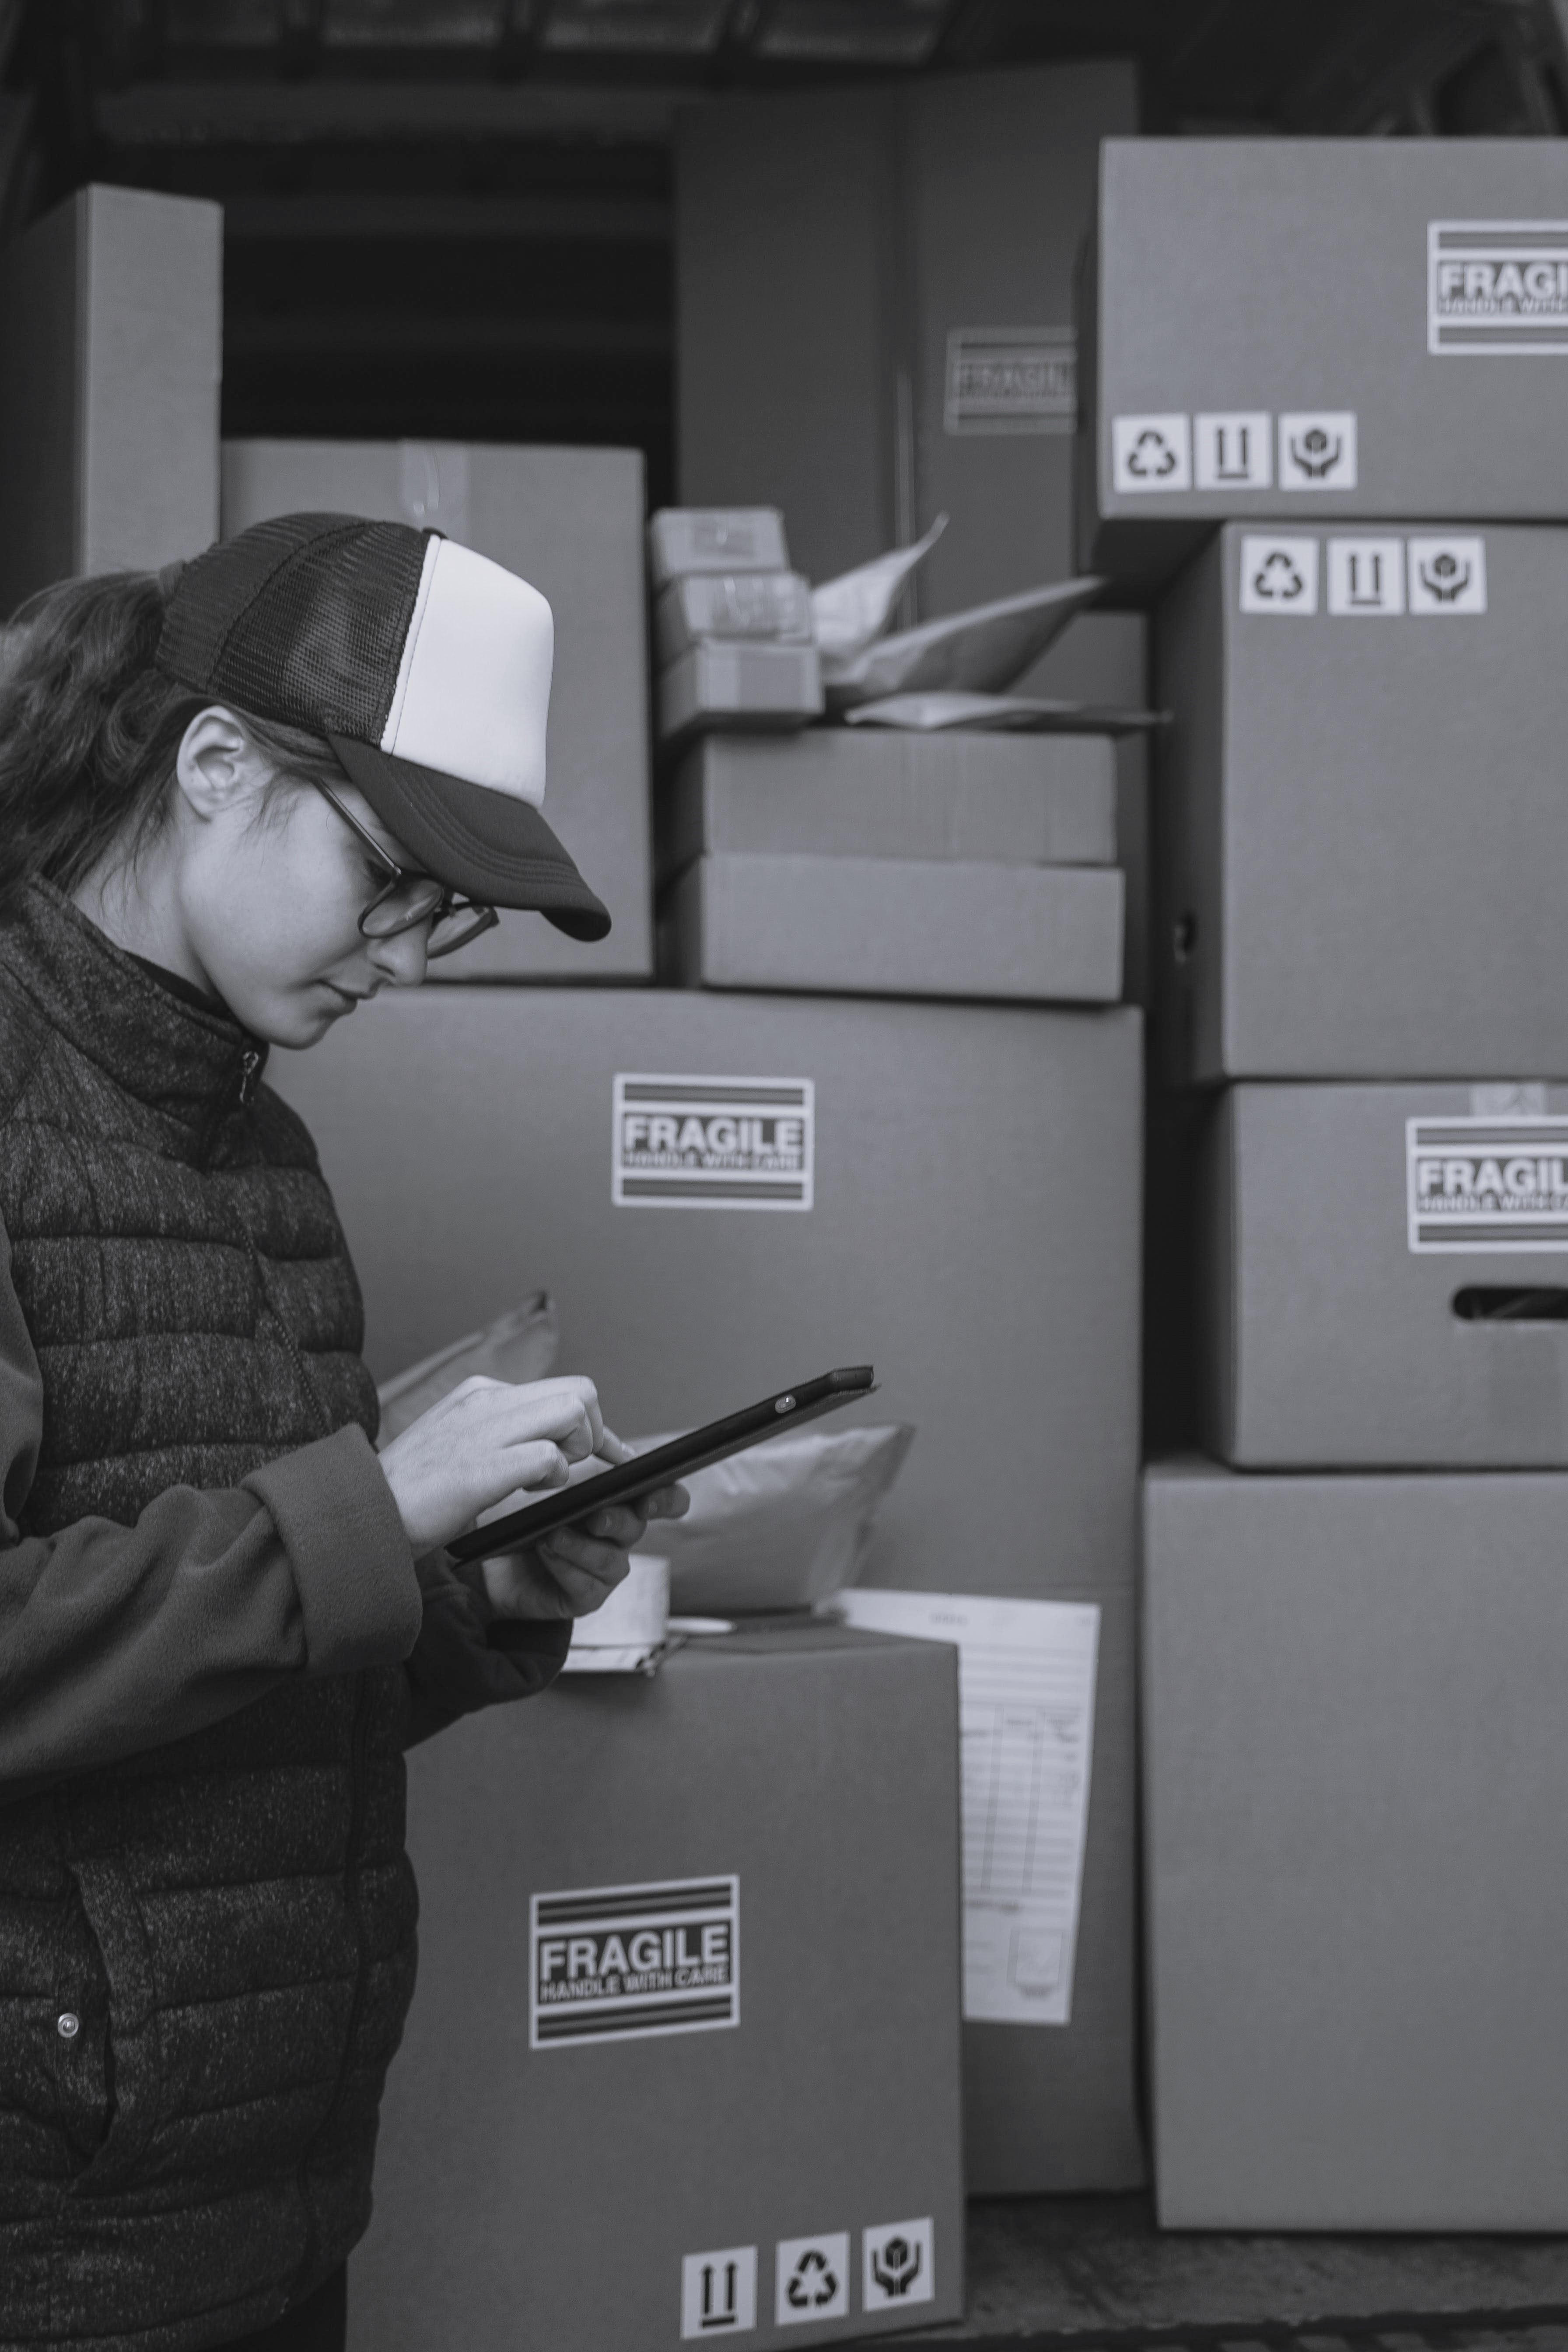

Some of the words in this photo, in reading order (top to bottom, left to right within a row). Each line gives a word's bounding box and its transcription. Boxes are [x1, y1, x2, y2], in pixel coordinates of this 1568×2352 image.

[625, 1115, 802, 1155] FRAGILE
[1419, 1158, 1568, 1195] FRAGIL
[540, 1925, 729, 1981] FRAGILE
[539, 1974, 622, 2002] HANDLE
[623, 1968, 673, 1992] WITH
[675, 1965, 728, 1987] CARE
